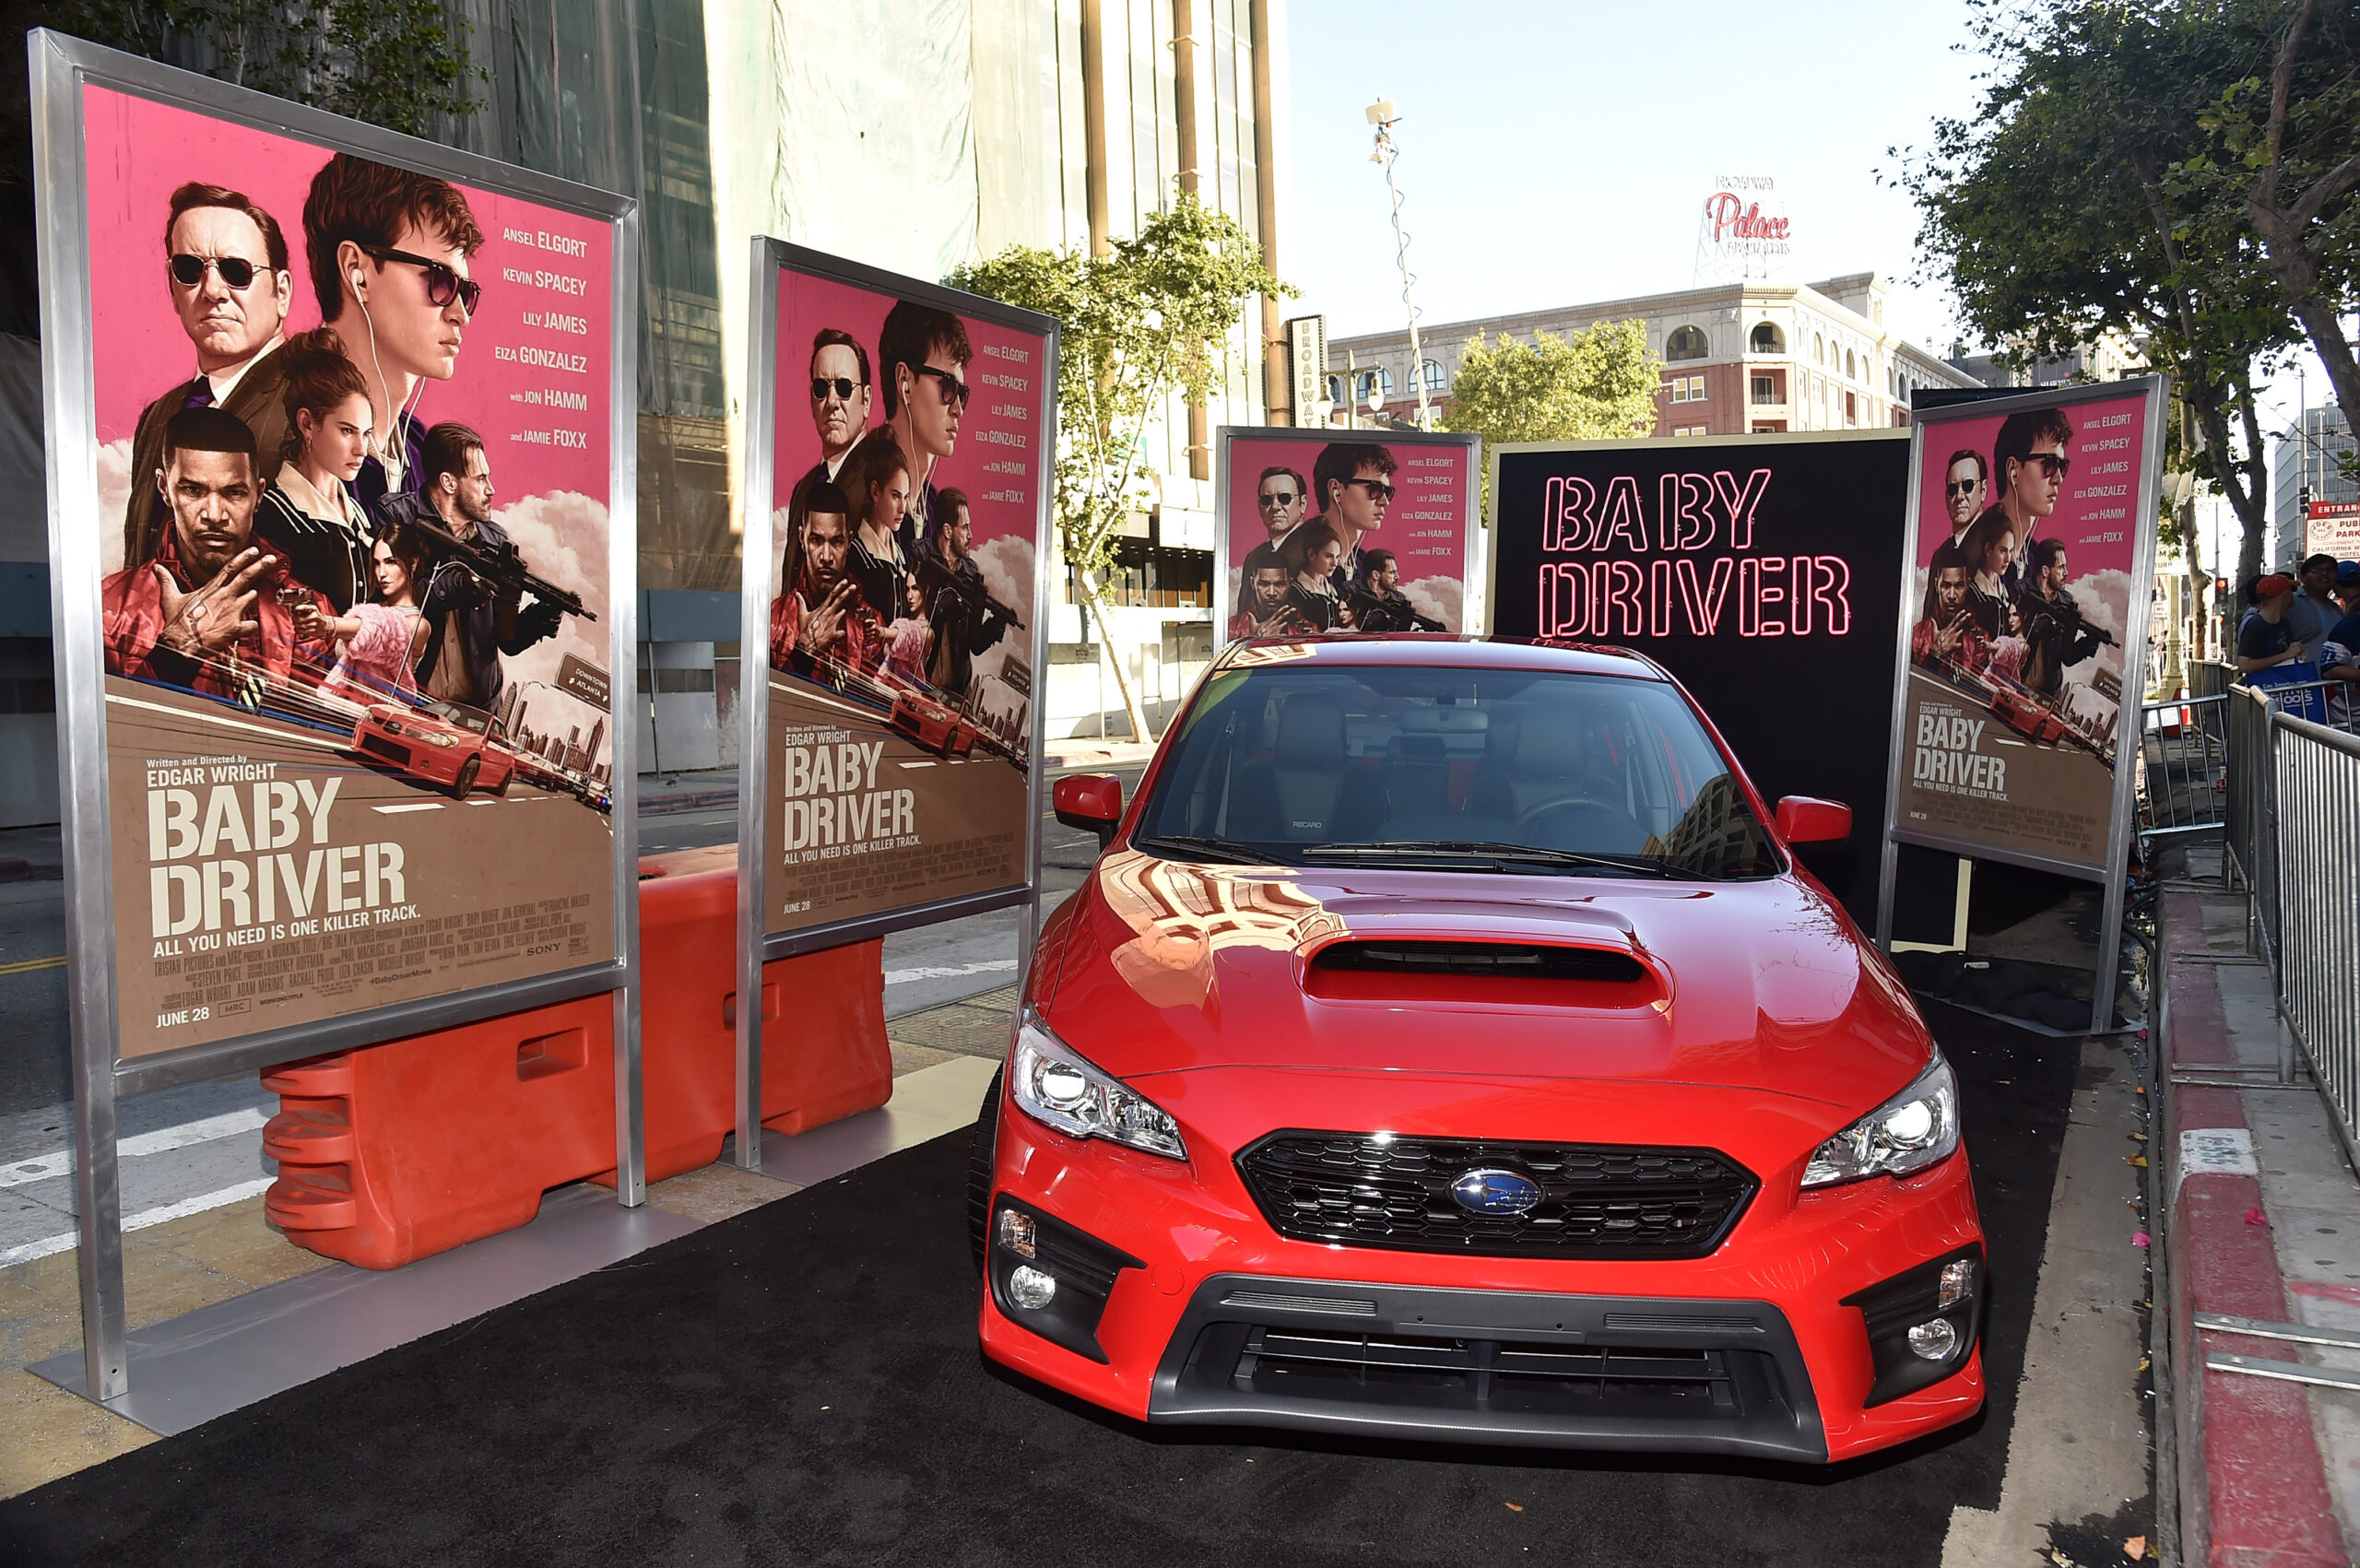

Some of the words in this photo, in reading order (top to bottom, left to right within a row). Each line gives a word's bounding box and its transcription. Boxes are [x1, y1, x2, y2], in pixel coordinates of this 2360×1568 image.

[1706, 192, 1790, 242] Palace
[503, 227, 535, 246] ANSEL
[537, 230, 587, 258] ELGORT
[503, 267, 532, 286] KEVIN
[536, 270, 586, 296] SPACEY
[524, 312, 541, 326] LILY
[544, 312, 586, 335] JAMES
[495, 347, 517, 361] EIZA
[520, 347, 586, 373] GONZALEZ
[983, 346, 1000, 357] ANSEL
[1002, 347, 1029, 364] ELGORT
[982, 374, 998, 386] KEVIN
[999, 375, 1028, 392] SPACEY
[1302, 323, 1315, 428] BROADWAY
[510, 393, 523, 402] with
[524, 390, 541, 405] JON
[545, 389, 587, 411] HAMM
[992, 405, 1002, 415] LILY
[1003, 405, 1027, 419] JAMES
[2083, 420, 2100, 430] ANSEL
[2103, 414, 2131, 427] ELGORT
[511, 433, 522, 442] and
[523, 430, 550, 444] JAMIE
[554, 430, 586, 449] FOXX
[975, 431, 987, 442] EIZA
[989, 430, 1026, 448] GONZALEZ
[2082, 443, 2098, 453] KEVIN
[2099, 437, 2130, 451] SPACEY
[990, 462, 1000, 472] JON
[1002, 461, 1025, 476] HAMM
[1426, 459, 1453, 467] ELGORT
[2091, 466, 2102, 475] LILY
[2103, 461, 2129, 474] JAMES
[1424, 477, 1453, 485] SPACEY
[989, 490, 1004, 501] JAMIE
[1006, 489, 1024, 503] FOXX
[2074, 490, 2086, 499] EIZA
[2088, 485, 2127, 497] GONZALEZ
[1543, 468, 1771, 552] BABY
[2088, 512, 2098, 520] JON
[2099, 508, 2125, 520] HAMM
[1428, 529, 1452, 538] HAMM
[2086, 535, 2102, 543] JAMIE
[2103, 532, 2123, 543] FOXX
[1433, 548, 1451, 556] FOXX
[1540, 555, 1850, 638] DRIVER
[575, 668, 608, 690] DOWNTOWN
[576, 680, 601, 697] ATLANTA
[1919, 706, 1938, 714] EDGAR
[1939, 708, 1962, 717] WRIGHT
[785, 733, 814, 746] EDGAR
[818, 730, 851, 743] WRIGHT
[1917, 714, 1985, 752] BABY
[147, 758, 180, 767] Written
[200, 756, 235, 764] Directed
[238, 754, 247, 763] by
[785, 741, 884, 797] BABY
[1914, 748, 2006, 791] DRIVER
[148, 768, 205, 787] EDGAR
[211, 763, 277, 783] WRIGHT
[1924, 782, 1934, 790] YOU
[1936, 784, 1949, 792] NEED
[1957, 786, 1968, 796] ONE
[1969, 788, 1988, 798] KILLER
[148, 777, 343, 861] BABY
[785, 789, 914, 851] DRIVER
[785, 854, 798, 865] ALL
[801, 851, 818, 862] YOU
[820, 847, 840, 860] NEED
[844, 845, 850, 855] IS
[853, 843, 867, 855] ONE
[870, 839, 894, 852] KILLER
[897, 835, 921, 848] TRACK.
[150, 843, 406, 937] DRIVER
[784, 902, 800, 914] JUNE
[801, 901, 810, 912] 28
[154, 938, 183, 958] ALL
[188, 934, 220, 952] YOU
[227, 928, 266, 947] NEED
[271, 925, 285, 939] IS
[290, 919, 318, 937] ONE
[324, 913, 369, 932] KILLER
[373, 904, 420, 923] TRACK.
[526, 943, 561, 957] SONY
[155, 959, 181, 977] TRISTAR
[228, 950, 242, 965] MRC
[198, 970, 221, 987] STEVEN
[371, 968, 432, 984] #BabyDriverMovie
[225, 1003, 244, 1012] MRC
[156, 1010, 189, 1028] JUNE
[193, 1007, 209, 1022] 28
